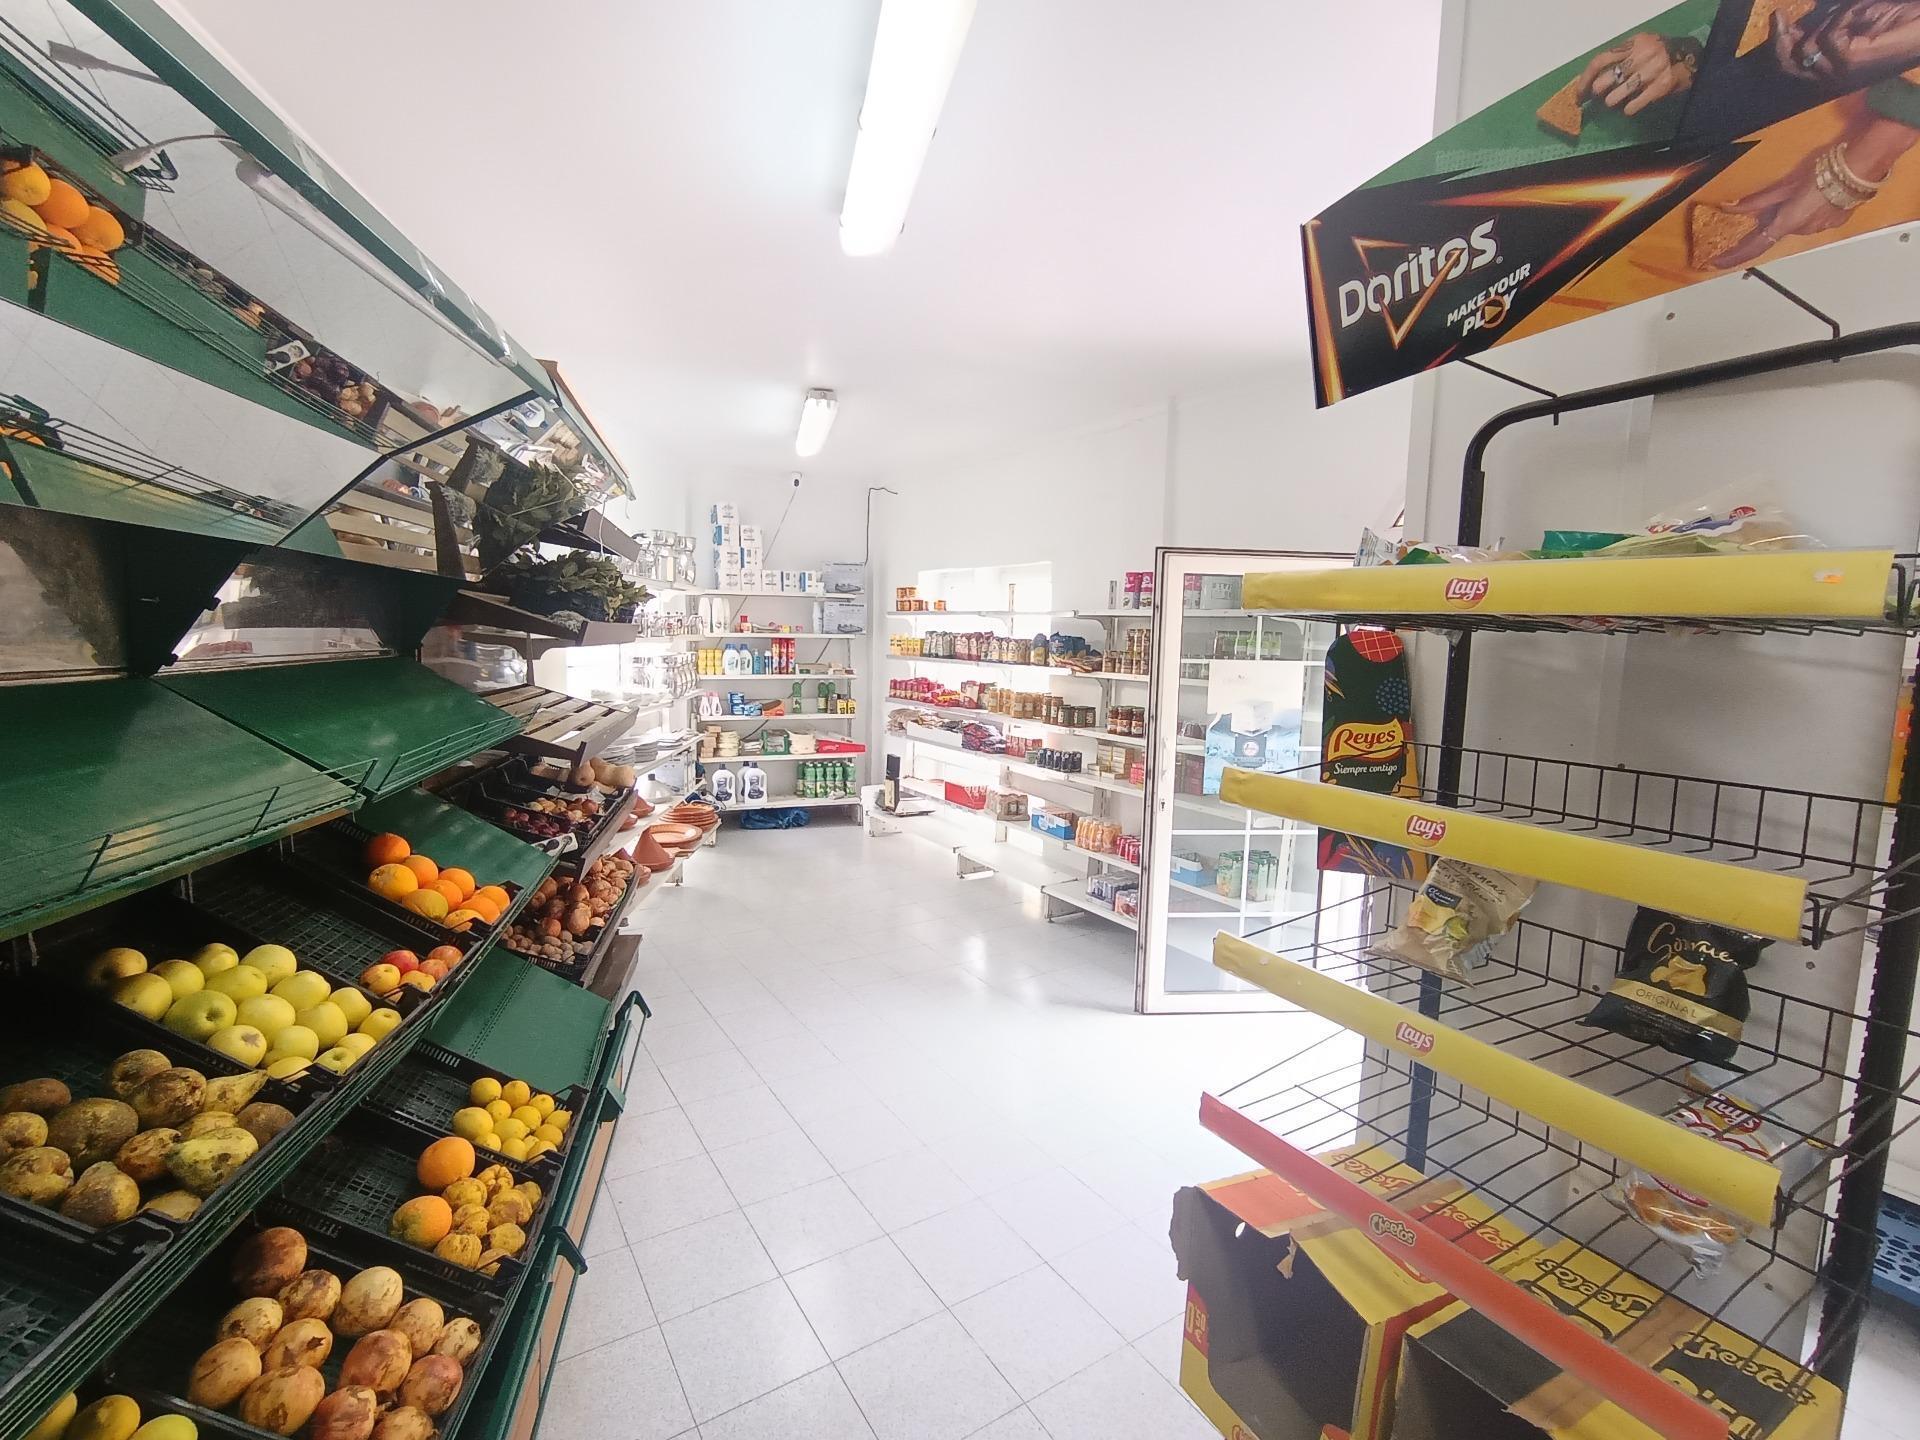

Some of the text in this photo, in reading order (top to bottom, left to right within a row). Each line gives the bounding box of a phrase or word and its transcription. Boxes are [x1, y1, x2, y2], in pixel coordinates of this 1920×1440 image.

[1339, 218, 1498, 329] Doritos
[1447, 263, 1531, 327] MAKE YOUR
[1333, 728, 1396, 753] Reyes
[1333, 762, 1398, 776] Siempre contigo
[1635, 987, 1698, 1019] ORIGINAL
[1370, 1214, 1416, 1246] Cheetos
